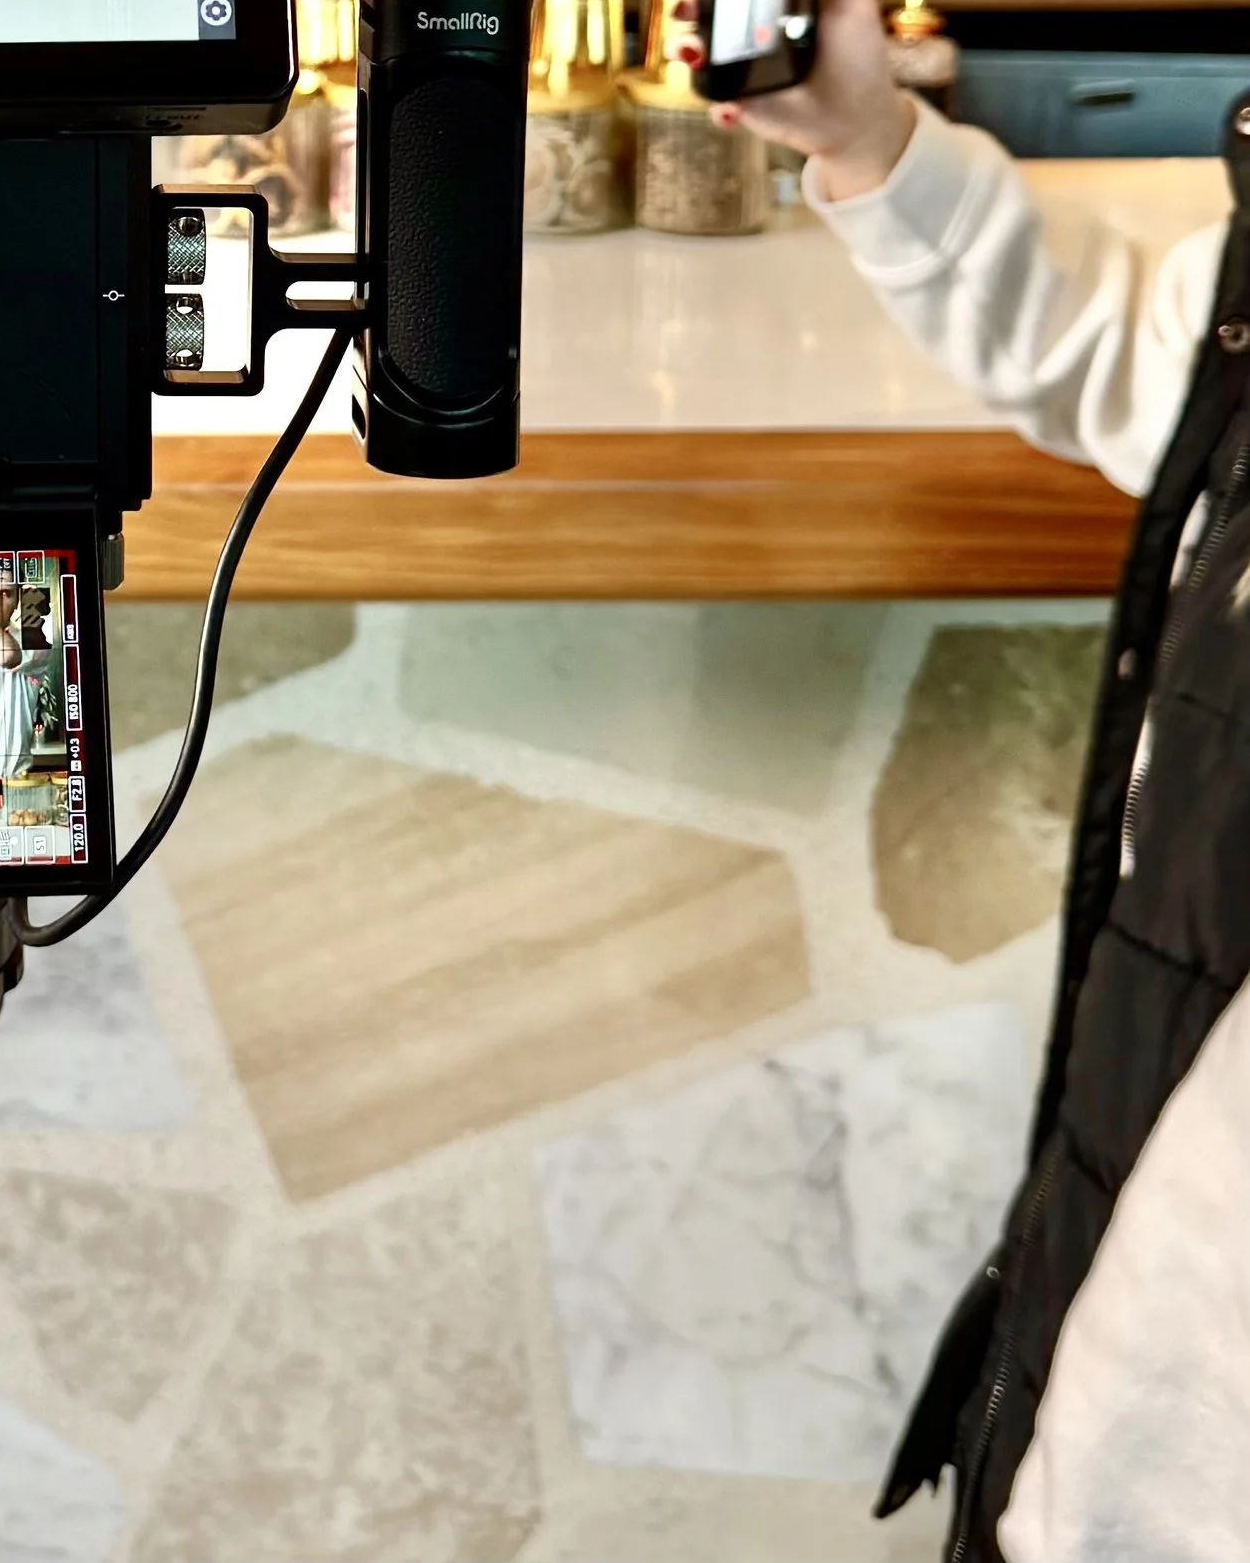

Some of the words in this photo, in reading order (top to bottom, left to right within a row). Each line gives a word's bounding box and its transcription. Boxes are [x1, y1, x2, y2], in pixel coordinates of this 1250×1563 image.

[416, 11, 500, 35] SmallRig
[67, 684, 79, 703] 800
[69, 704, 80, 720] ISO
[71, 779, 83, 801] F2.8
[73, 823, 85, 852] 120.0
